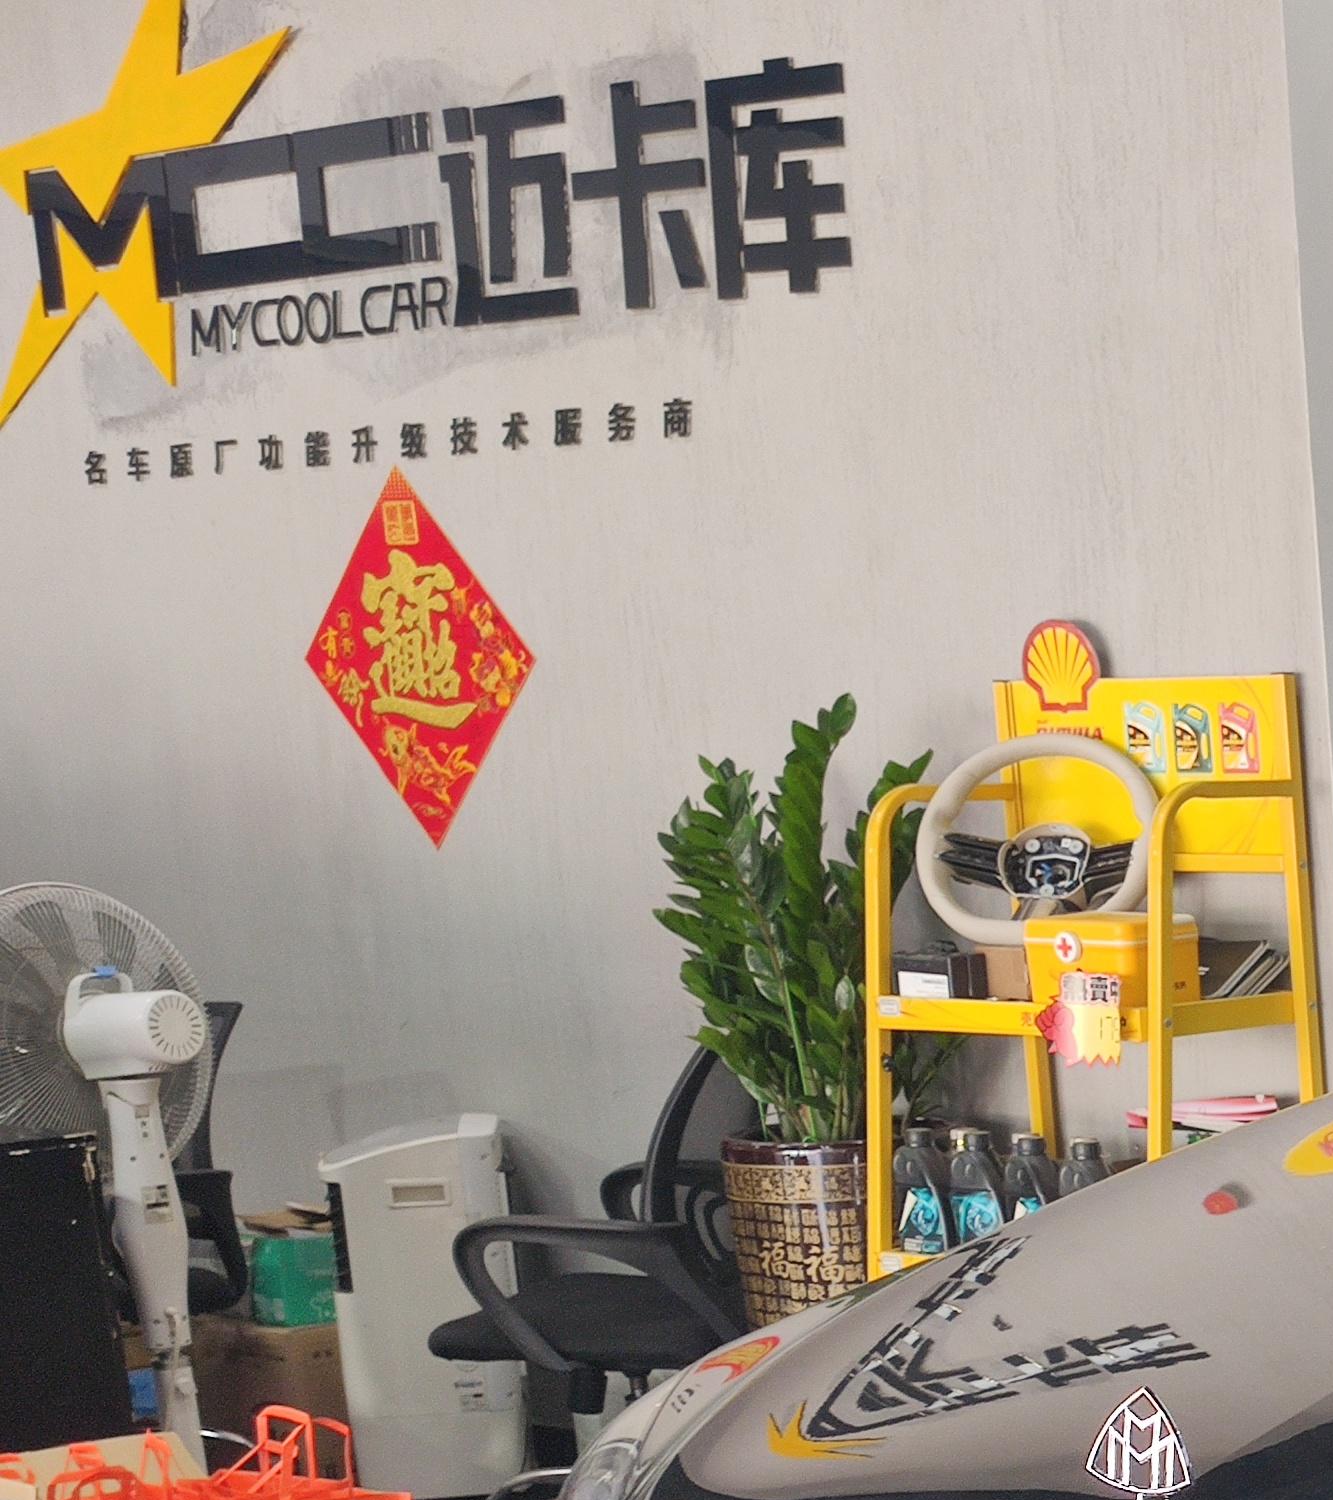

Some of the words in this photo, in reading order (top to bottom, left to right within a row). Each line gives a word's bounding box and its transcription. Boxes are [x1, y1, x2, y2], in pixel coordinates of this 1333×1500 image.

[437, 57, 853, 328] 迈卡库
[190, 274, 450, 357] MYCOOLCAR
[84, 397, 694, 487] 名车原厂功能升级技术服务商
[761, 1241, 790, 1279] 福
[804, 1246, 844, 1283] 福
